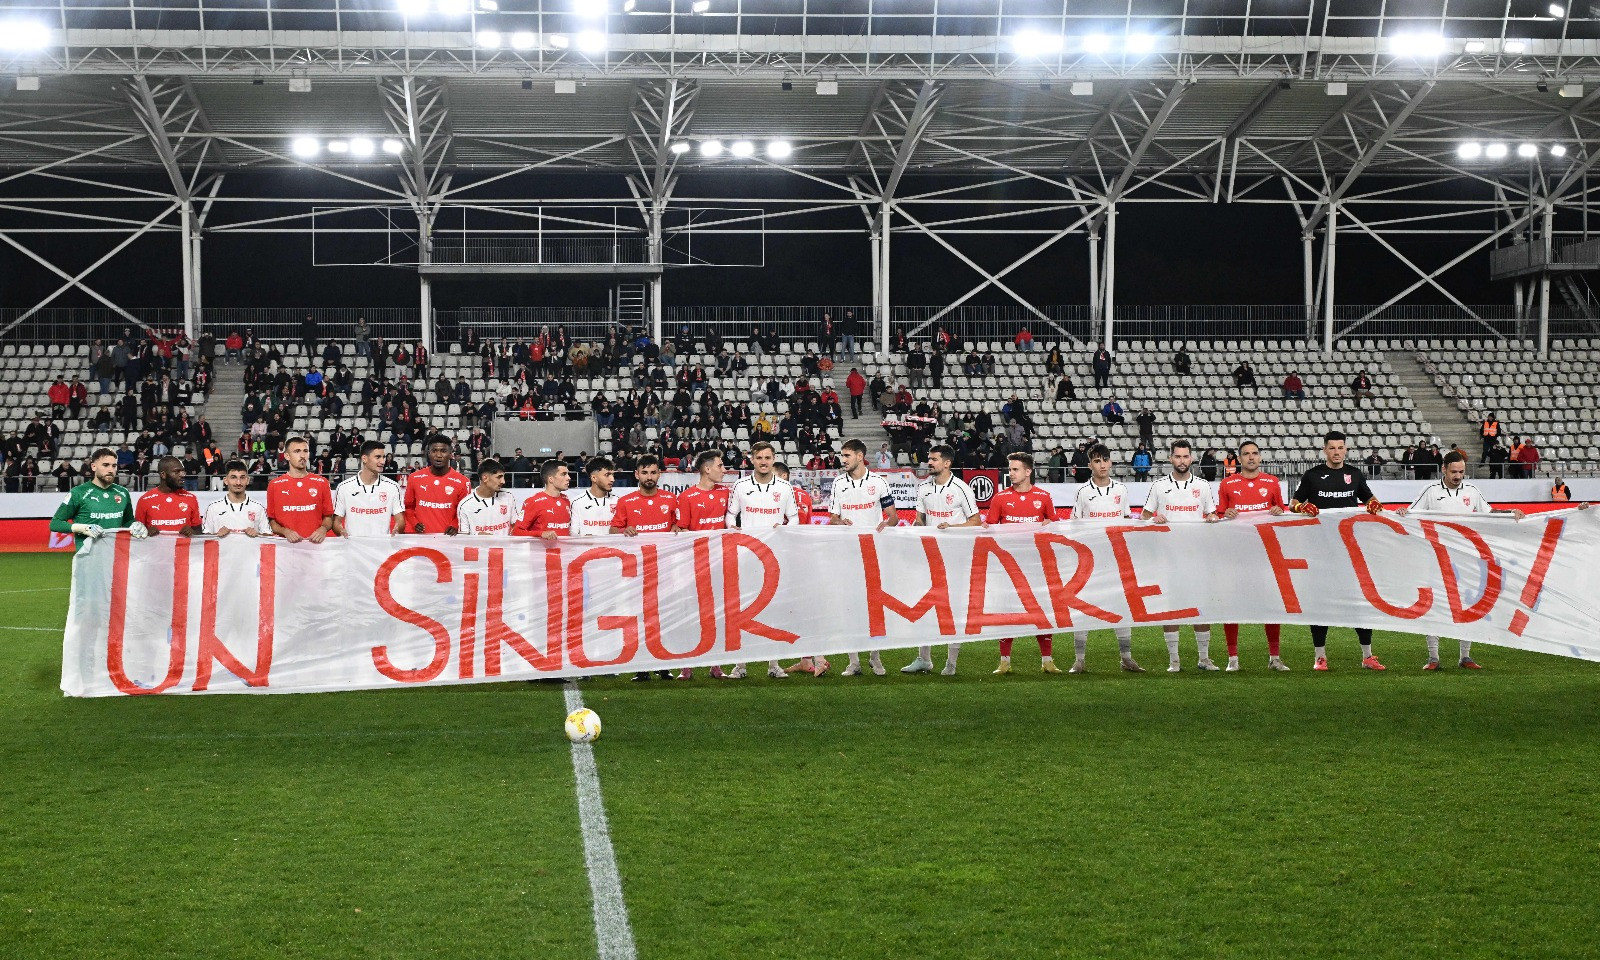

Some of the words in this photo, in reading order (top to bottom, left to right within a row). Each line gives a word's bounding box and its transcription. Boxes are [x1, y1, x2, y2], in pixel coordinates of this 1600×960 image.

[1318, 490, 1355, 498] SUPERBET
[282, 503, 317, 512] SUPERBET
[419, 499, 453, 509] SUPERBET
[841, 502, 875, 511] SUPERBET
[1165, 504, 1200, 512] SUPERBET
[1234, 501, 1269, 511] SUPERBET
[350, 506, 388, 515] SUPERBET
[745, 506, 781, 515] SUPERBET
[1089, 510, 1122, 518] SUPERBET
[90, 511, 124, 520] SUPERBET
[1005, 515, 1040, 523] SUPERBET
[150, 517, 187, 526] SUPERBET
[475, 520, 511, 532] SUPERBET
[635, 521, 669, 531] SUPERBET
[107, 531, 276, 695] UN
[858, 524, 1199, 636] MARE
